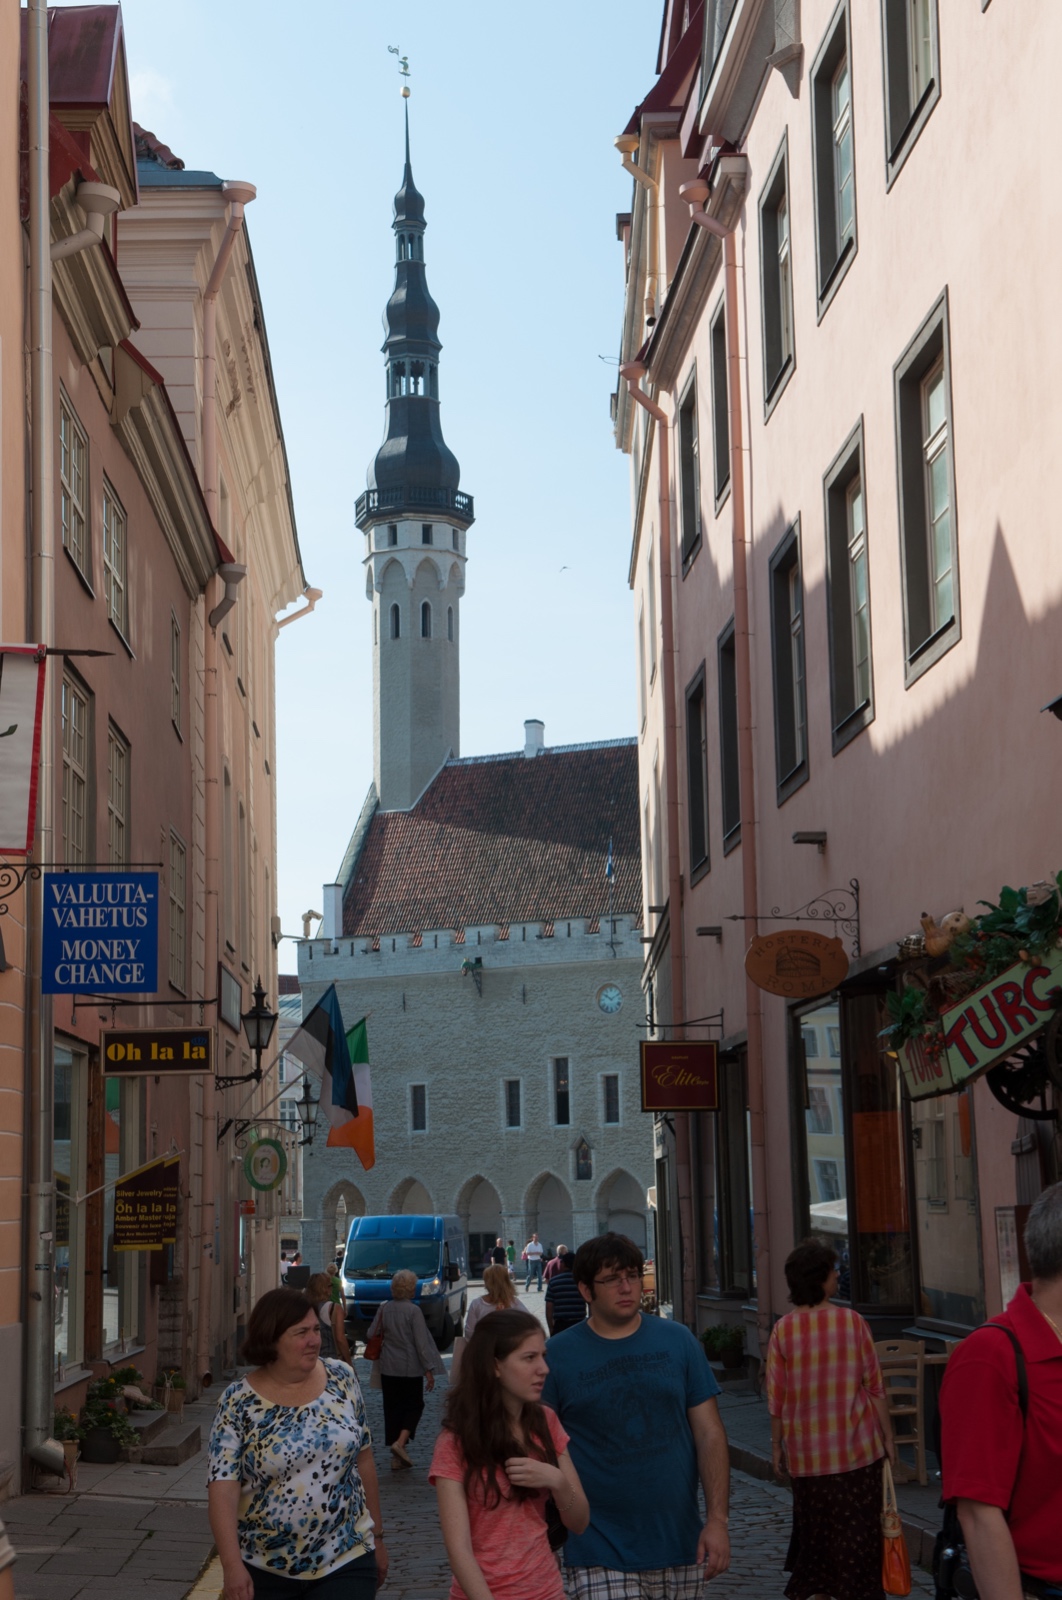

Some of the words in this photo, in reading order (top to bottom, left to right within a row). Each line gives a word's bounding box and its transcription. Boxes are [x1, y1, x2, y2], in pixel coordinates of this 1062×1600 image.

[51, 883, 154, 904] VALUUTA-
[52, 907, 148, 928] VAHETUS
[60, 939, 141, 961] MONEY
[754, 935, 837, 959] HOSTERIA
[54, 963, 145, 985] CHANGE
[764, 974, 833, 993] ROMA
[945, 966, 1062, 1069] TURG
[106, 1043, 142, 1062] Oh
[151, 1042, 174, 1060] la
[183, 1041, 206, 1060] la
[651, 1064, 702, 1088] Elite
[116, 1203, 132, 1213] Oh
[136, 1203, 147, 1213] la
[151, 1203, 162, 1213] la
